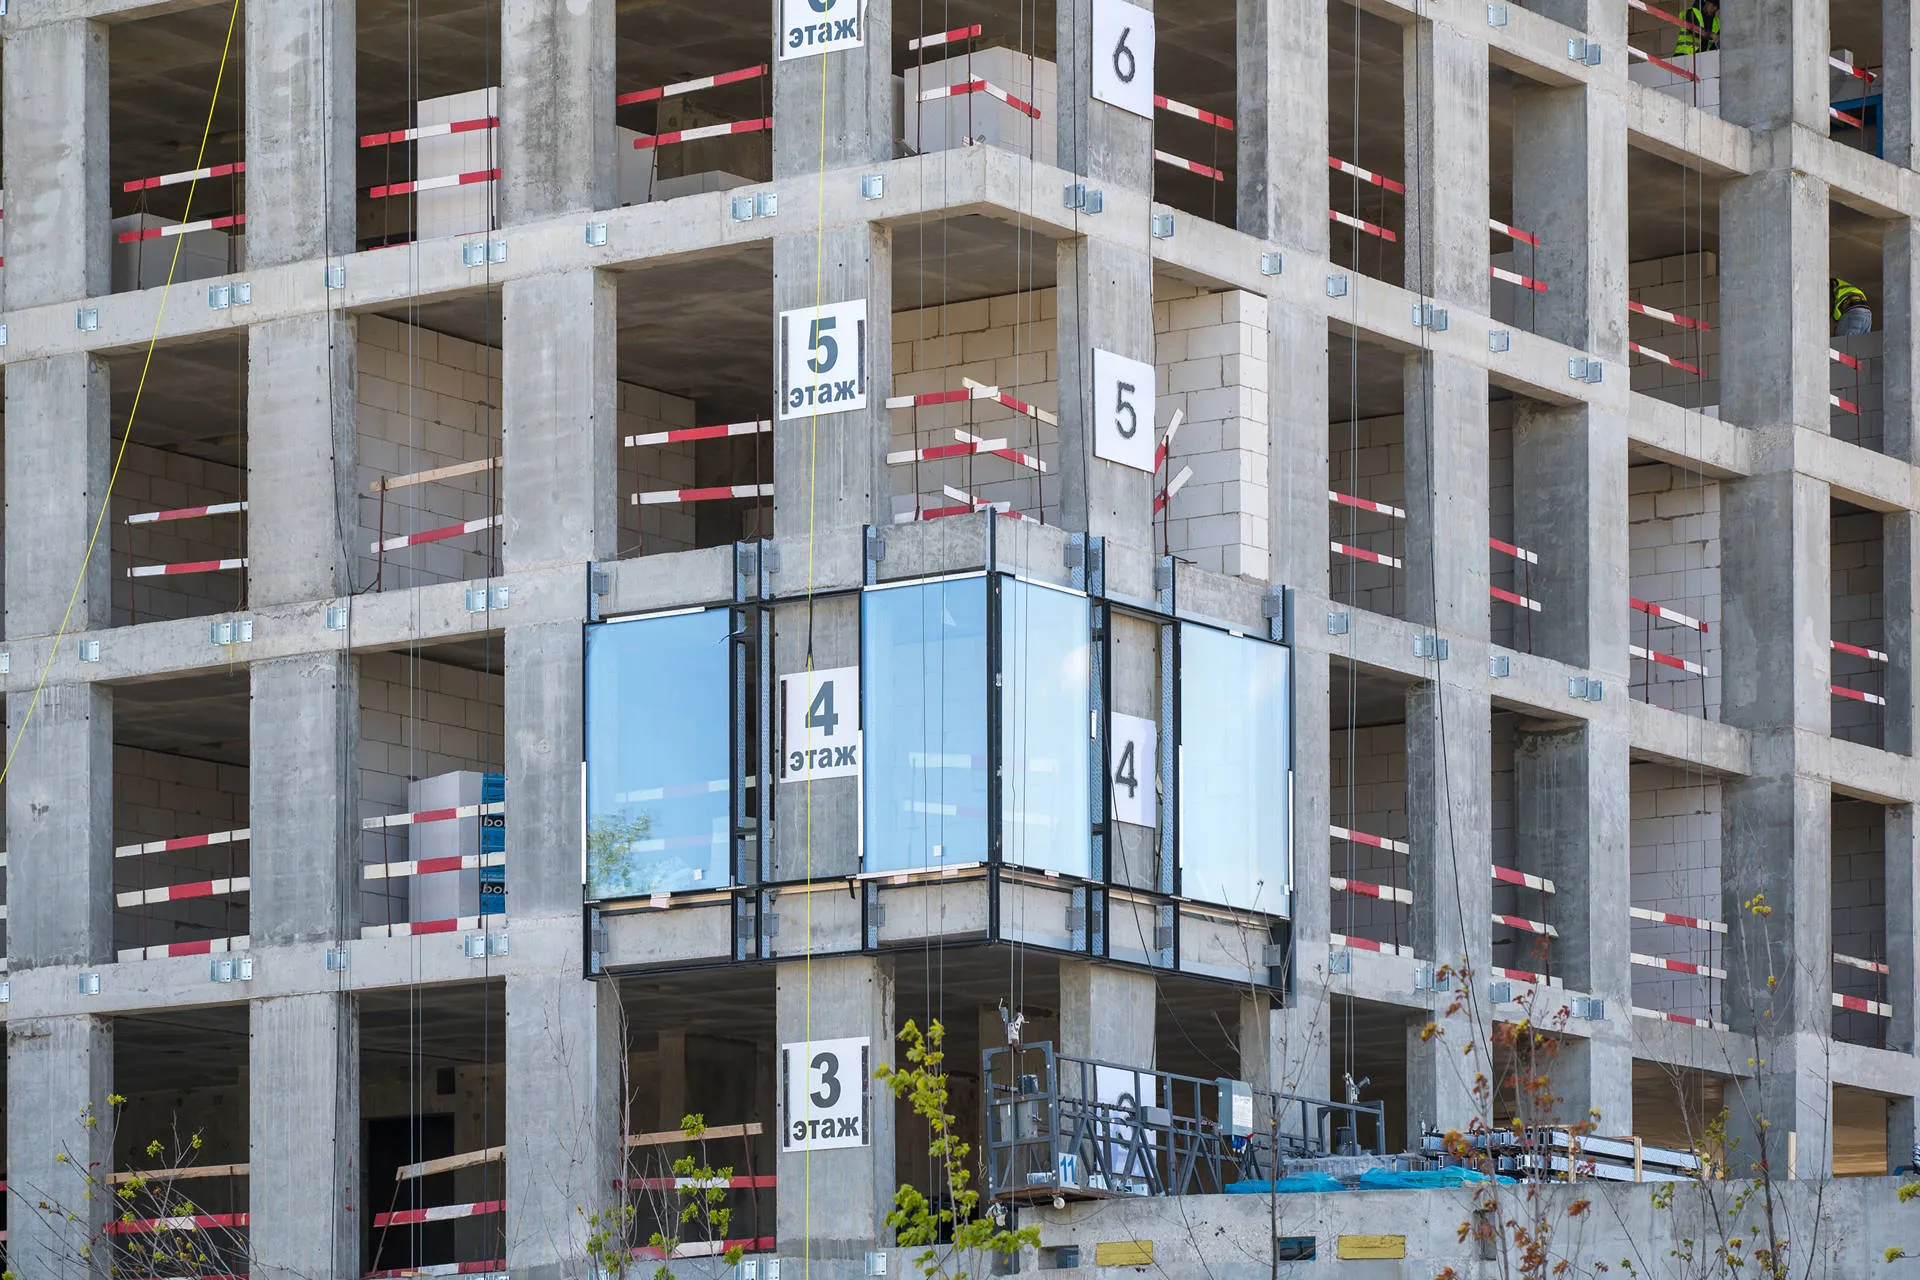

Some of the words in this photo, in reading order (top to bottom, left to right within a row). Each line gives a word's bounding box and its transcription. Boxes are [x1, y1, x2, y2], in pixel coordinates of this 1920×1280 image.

[789, 17, 856, 48] этаж
[1113, 28, 1135, 83] 6
[807, 317, 838, 374] 5
[789, 378, 856, 409] этаж
[1115, 381, 1137, 440] 5
[805, 681, 839, 737] 4
[789, 744, 858, 771] этаж
[1115, 740, 1138, 799] 4
[810, 1053, 841, 1109] 3
[793, 1114, 860, 1142] этаж
[1060, 1155, 1075, 1183] 11
